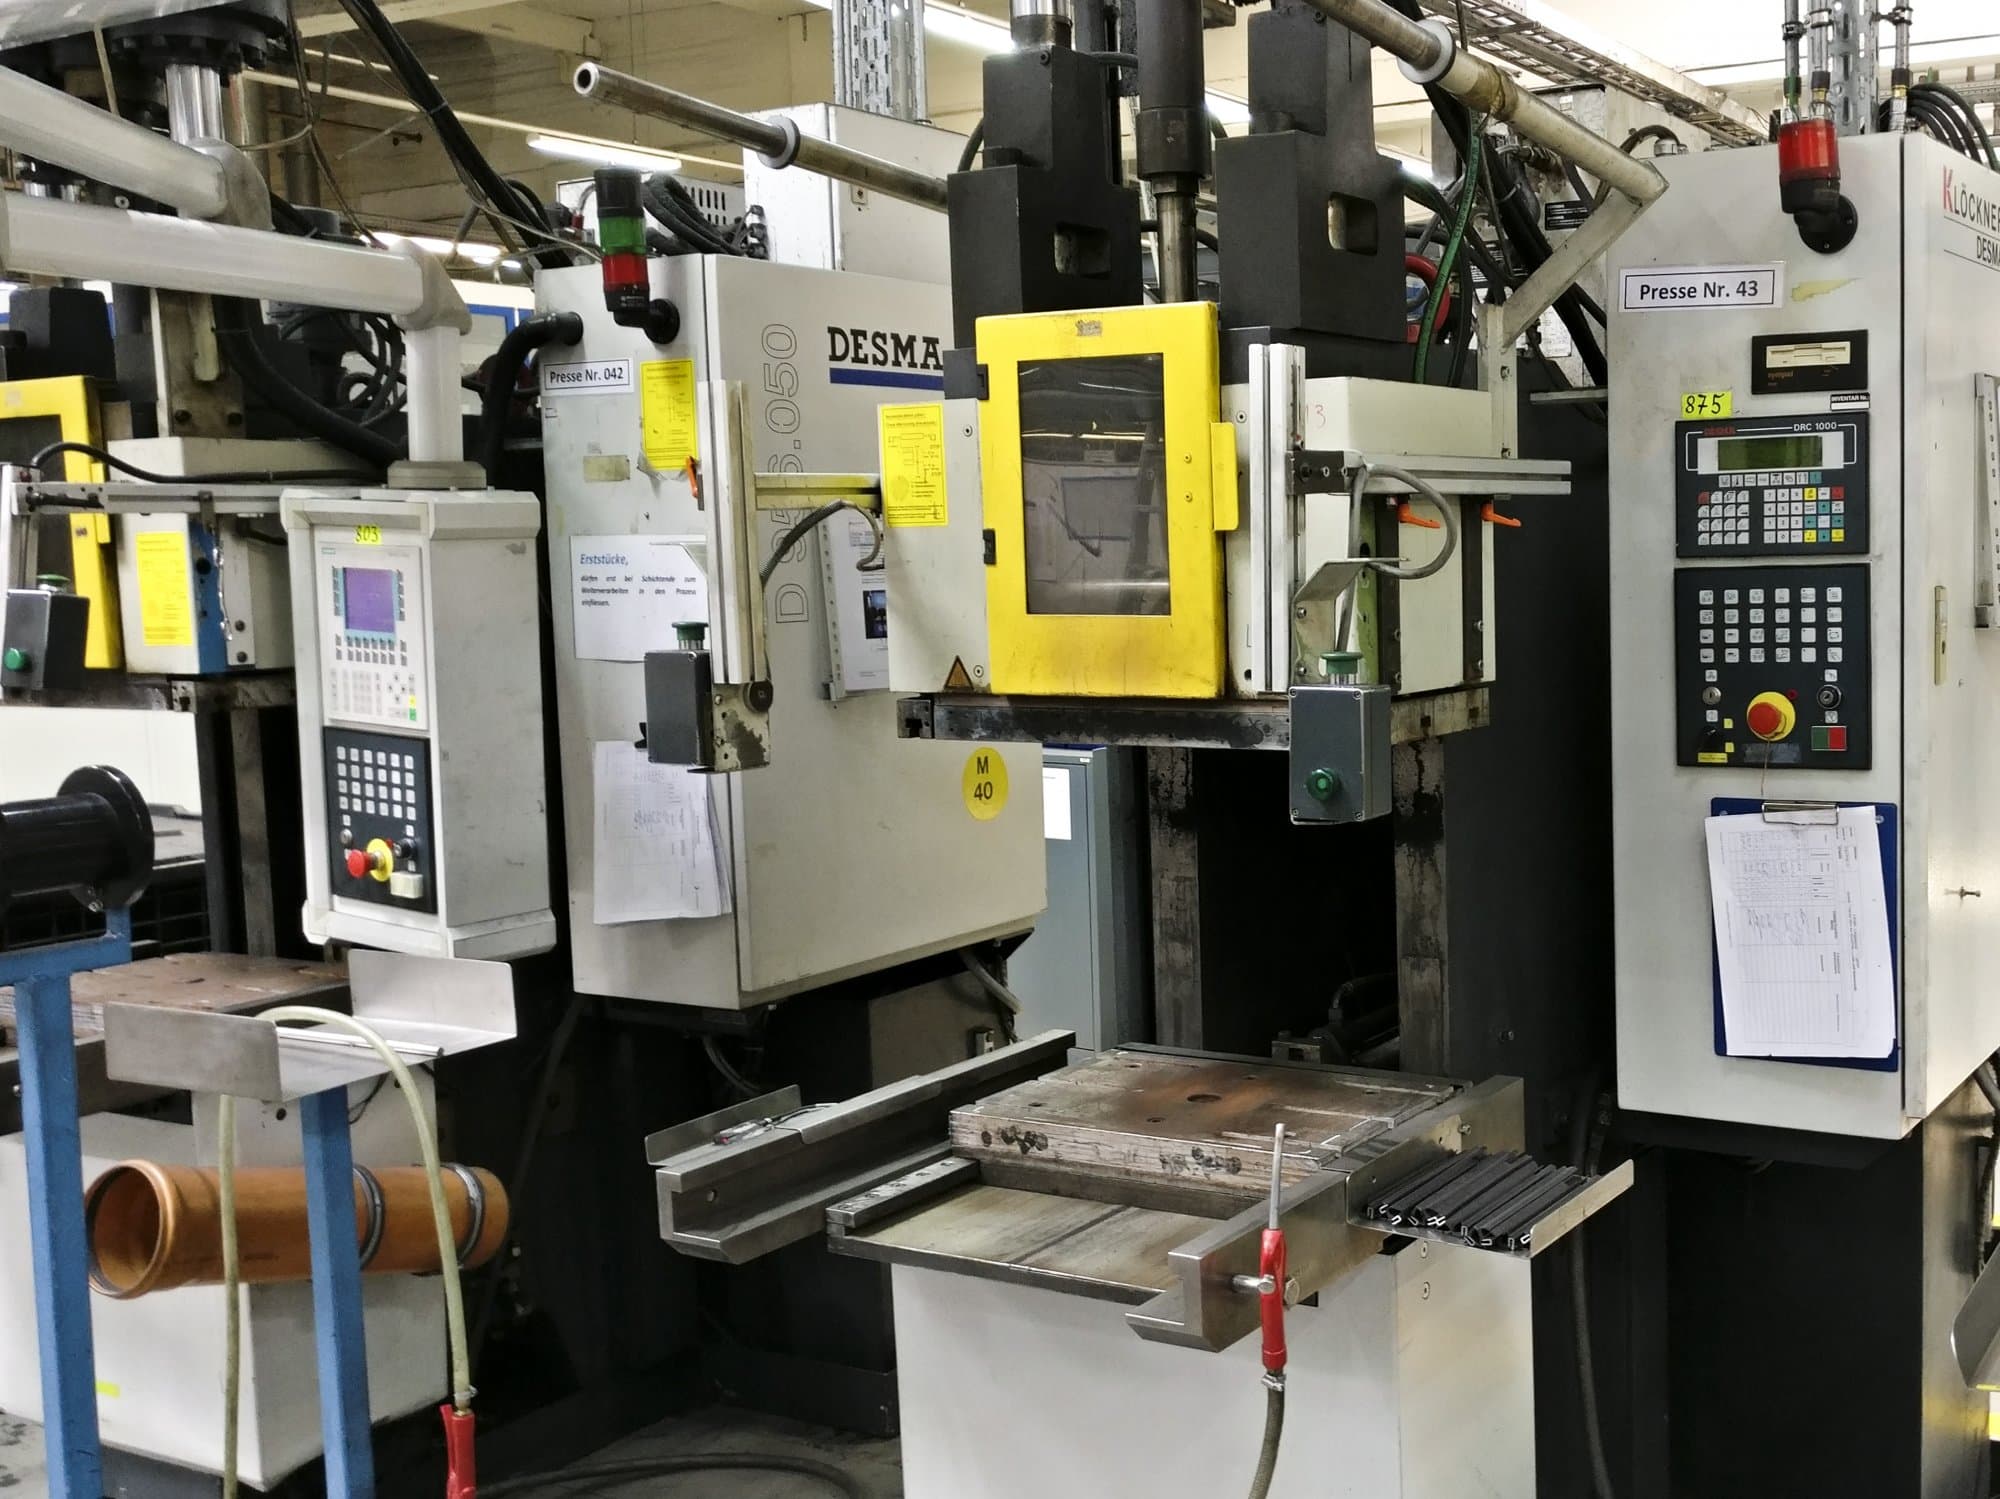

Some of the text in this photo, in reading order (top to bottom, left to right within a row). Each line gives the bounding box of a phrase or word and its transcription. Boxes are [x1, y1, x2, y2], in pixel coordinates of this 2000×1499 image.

[1943, 165, 2000, 233] KLÖCKNE
[1977, 235, 2000, 267] DESM
[1640, 280, 1758, 300] Presse Nr. 43
[827, 326, 944, 371] DESMA
[550, 367, 623, 384] Presse Nr. 042
[1685, 393, 1725, 415] 875
[1794, 421, 1837, 432] DRC 1000
[580, 553, 628, 566] Erststücke,
[977, 755, 989, 775] M
[974, 781, 993, 801] 40
